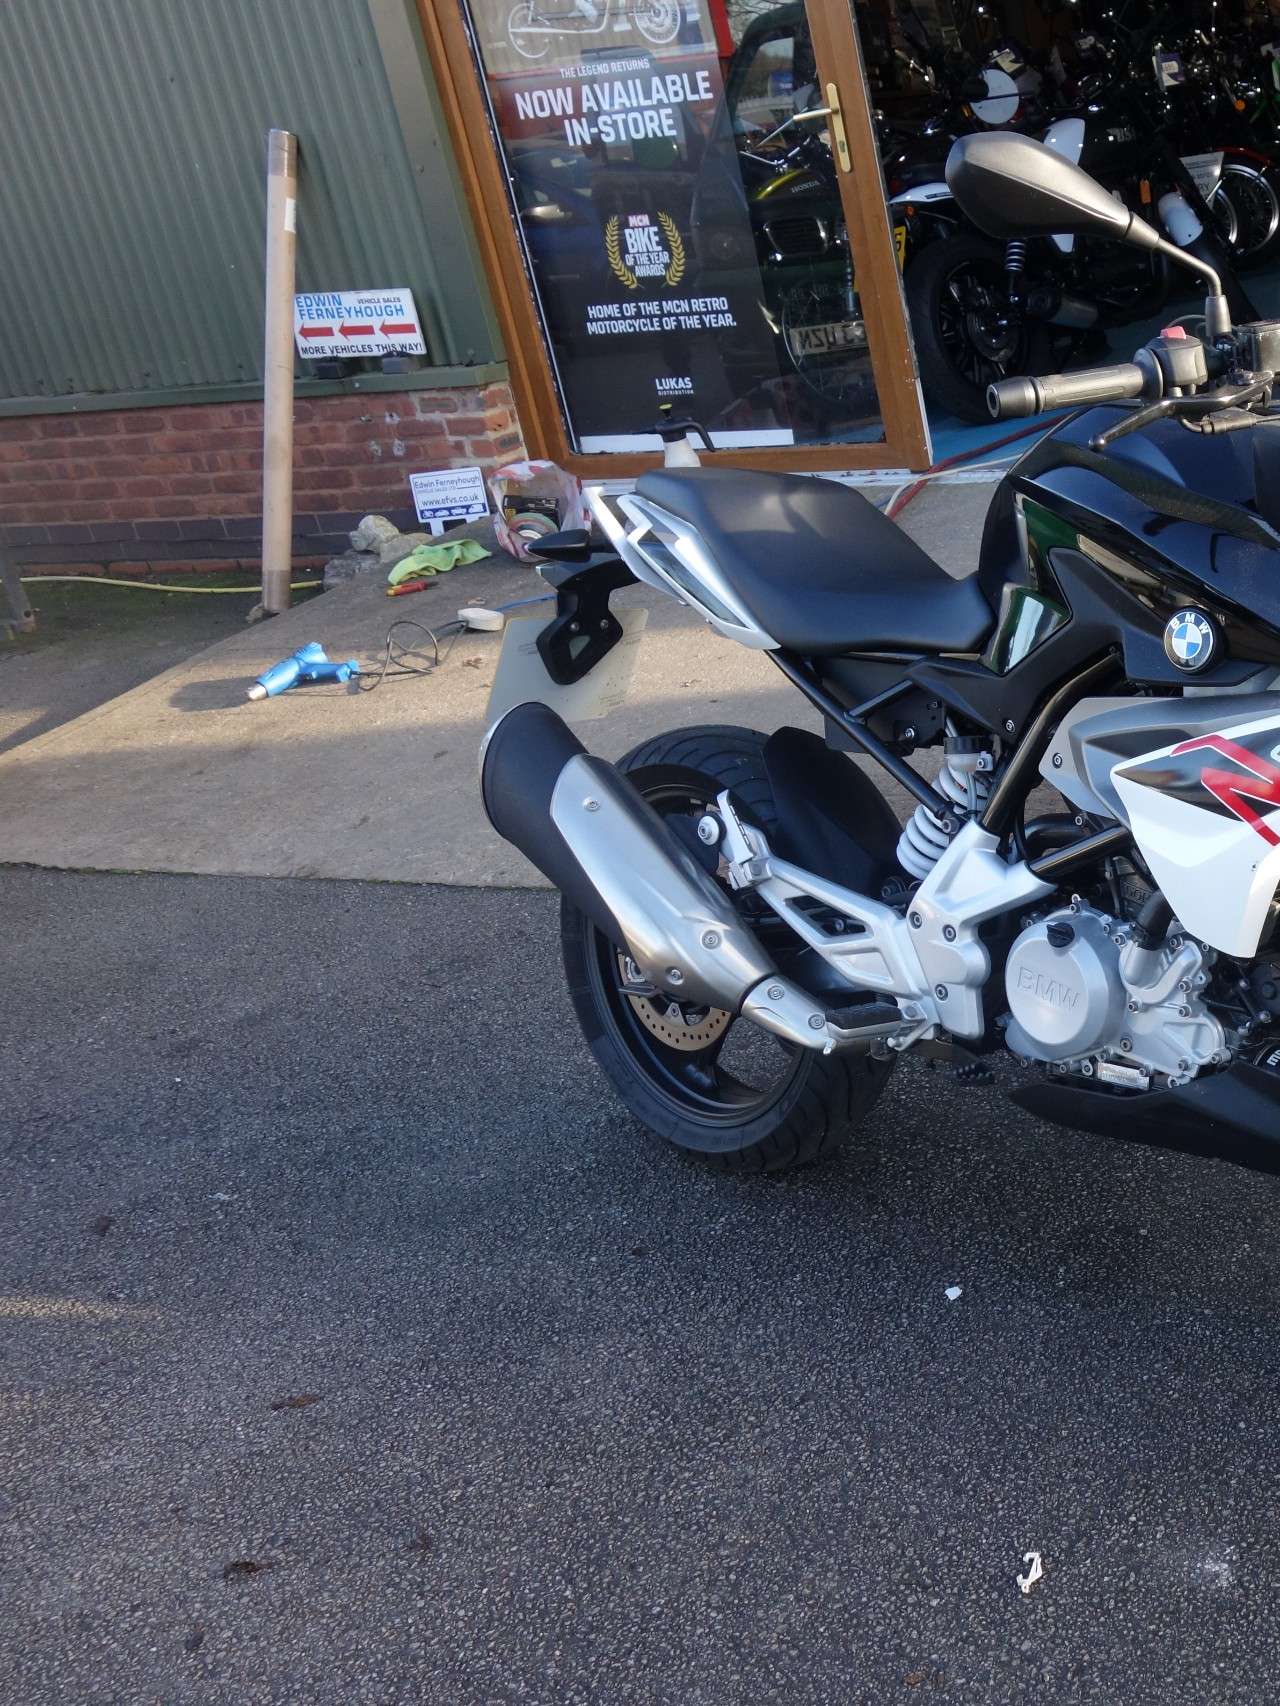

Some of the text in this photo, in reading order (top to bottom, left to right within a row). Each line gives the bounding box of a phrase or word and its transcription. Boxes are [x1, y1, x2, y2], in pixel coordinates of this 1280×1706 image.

[560, 58, 650, 79] THE LEGEND RETURNS
[514, 70, 714, 121] NOW AVAILABLE
[563, 108, 678, 147] IN-STORE
[628, 214, 650, 227] MCN
[624, 226, 663, 253] BIKE
[625, 251, 670, 266] OF THE YEAR
[634, 264, 666, 277] AWARDS
[296, 294, 401, 308] EDWIN VEHICLE SALES
[587, 297, 728, 319] HOME OF THE MCN RETRO
[299, 304, 405, 320] FERNEYHOUGH
[587, 313, 737, 336] MOTORCYCLE OF THE YEAR.
[301, 342, 423, 355] MORE VEHICLES THIS WAY!
[655, 376, 692, 390] LUKAS
[415, 479, 437, 489] Edwin
[1169, 611, 1212, 636] BMW
[1017, 965, 1081, 1012] BMW
